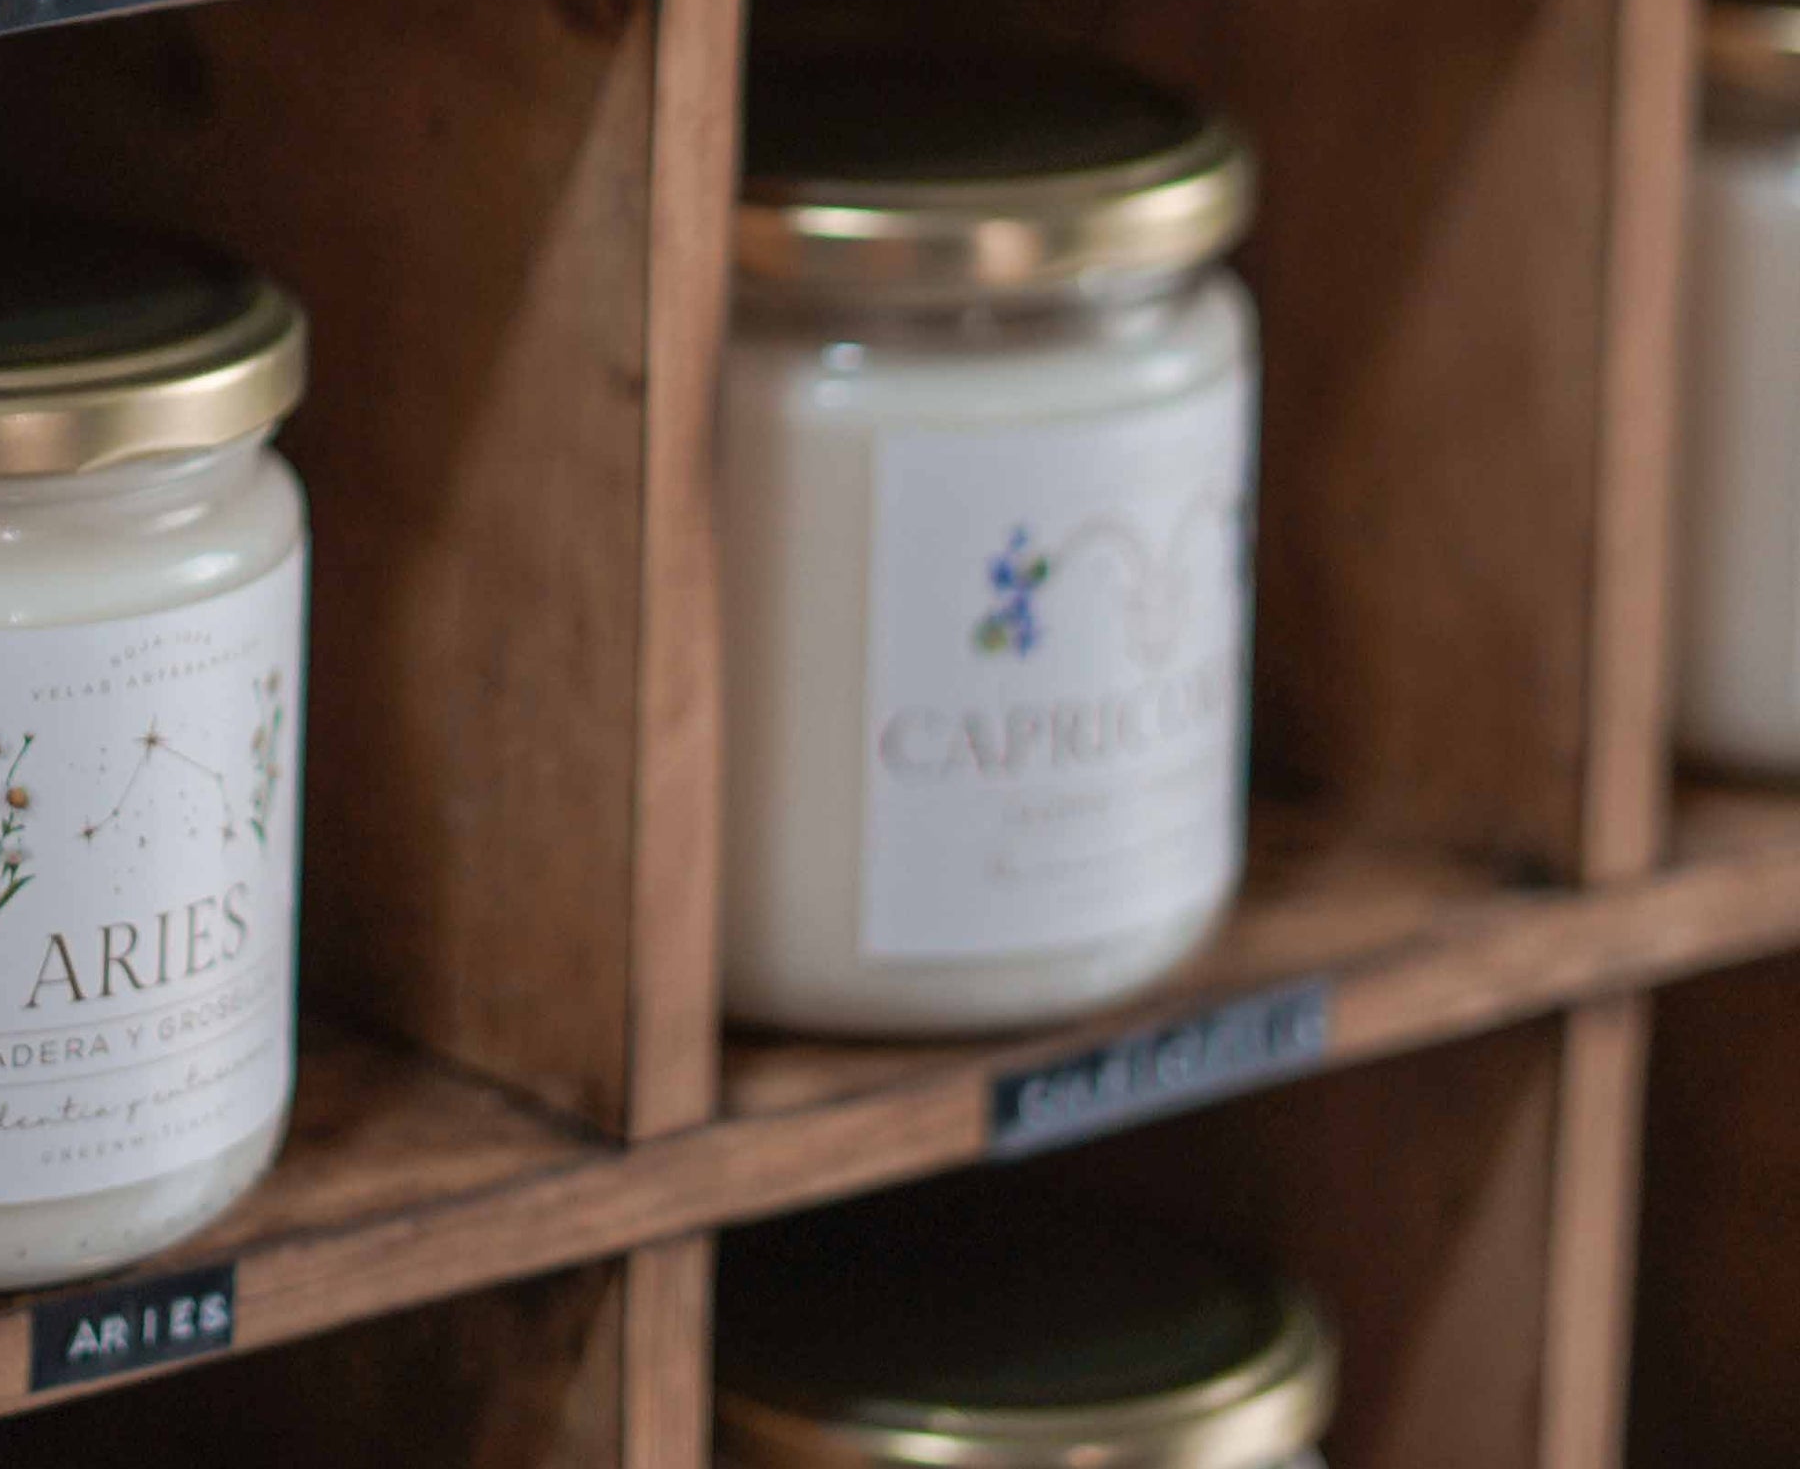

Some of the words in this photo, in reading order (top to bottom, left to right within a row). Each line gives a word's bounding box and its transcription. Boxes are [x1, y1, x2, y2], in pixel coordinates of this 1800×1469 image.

[23, 881, 251, 1011] ARIES
[125, 1024, 145, 1048] Y
[67, 1291, 230, 1360] ARIES
